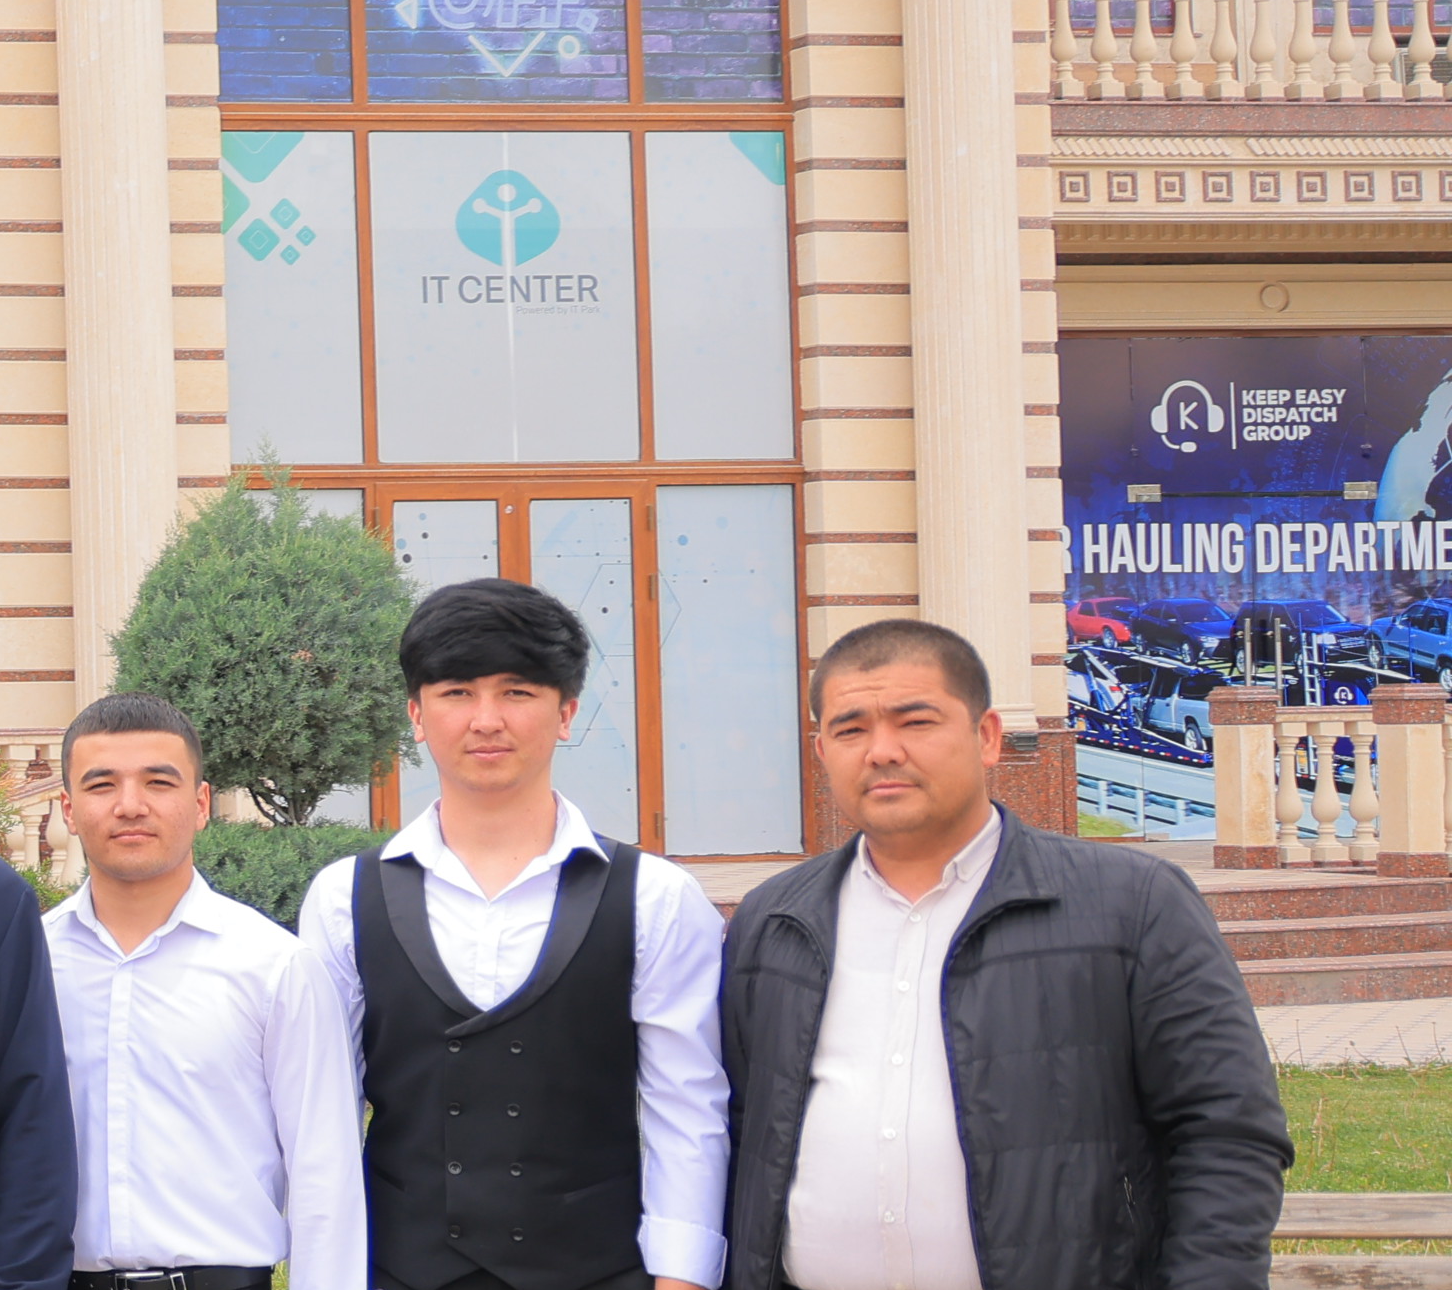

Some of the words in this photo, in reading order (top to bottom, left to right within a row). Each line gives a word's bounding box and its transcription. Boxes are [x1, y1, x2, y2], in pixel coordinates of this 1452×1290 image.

[421, 276, 450, 304] IT
[458, 275, 599, 304] CENTER
[516, 306, 555, 314] Powered
[1242, 389, 1292, 405] KEEP
[1295, 388, 1347, 405] EASY
[1179, 402, 1198, 430] K
[1243, 407, 1338, 423] DISPATCH
[1243, 425, 1311, 441] GROUP
[1083, 522, 1244, 574] HAULING
